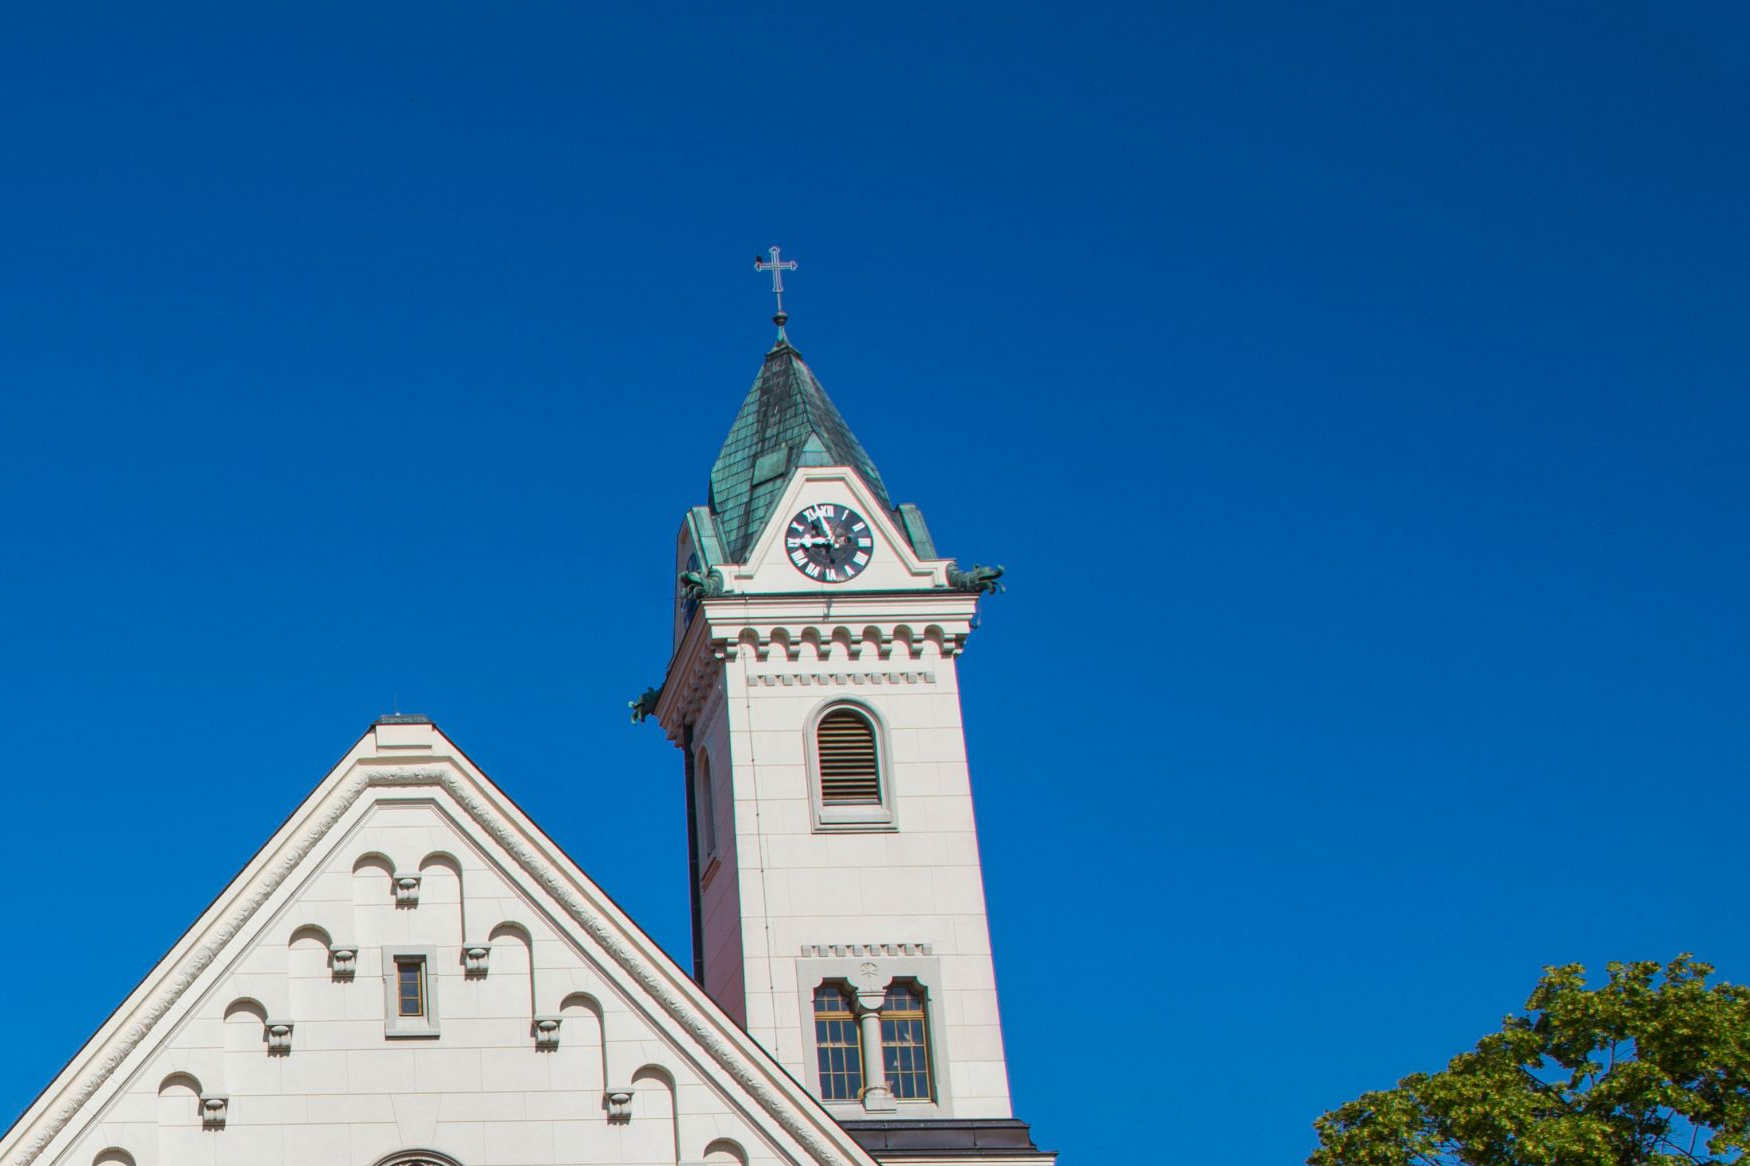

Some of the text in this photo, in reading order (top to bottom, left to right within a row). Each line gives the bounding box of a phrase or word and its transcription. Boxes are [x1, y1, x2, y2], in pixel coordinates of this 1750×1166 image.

[820, 505, 834, 518] XII
[842, 509, 849, 521] I
[790, 521, 804, 533] X
[852, 521, 866, 532] II
[858, 538, 871, 547] III
[790, 549, 808, 567] VIII
[805, 562, 820, 578] VII
[826, 568, 836, 581] VI
[844, 564, 855, 577] V
